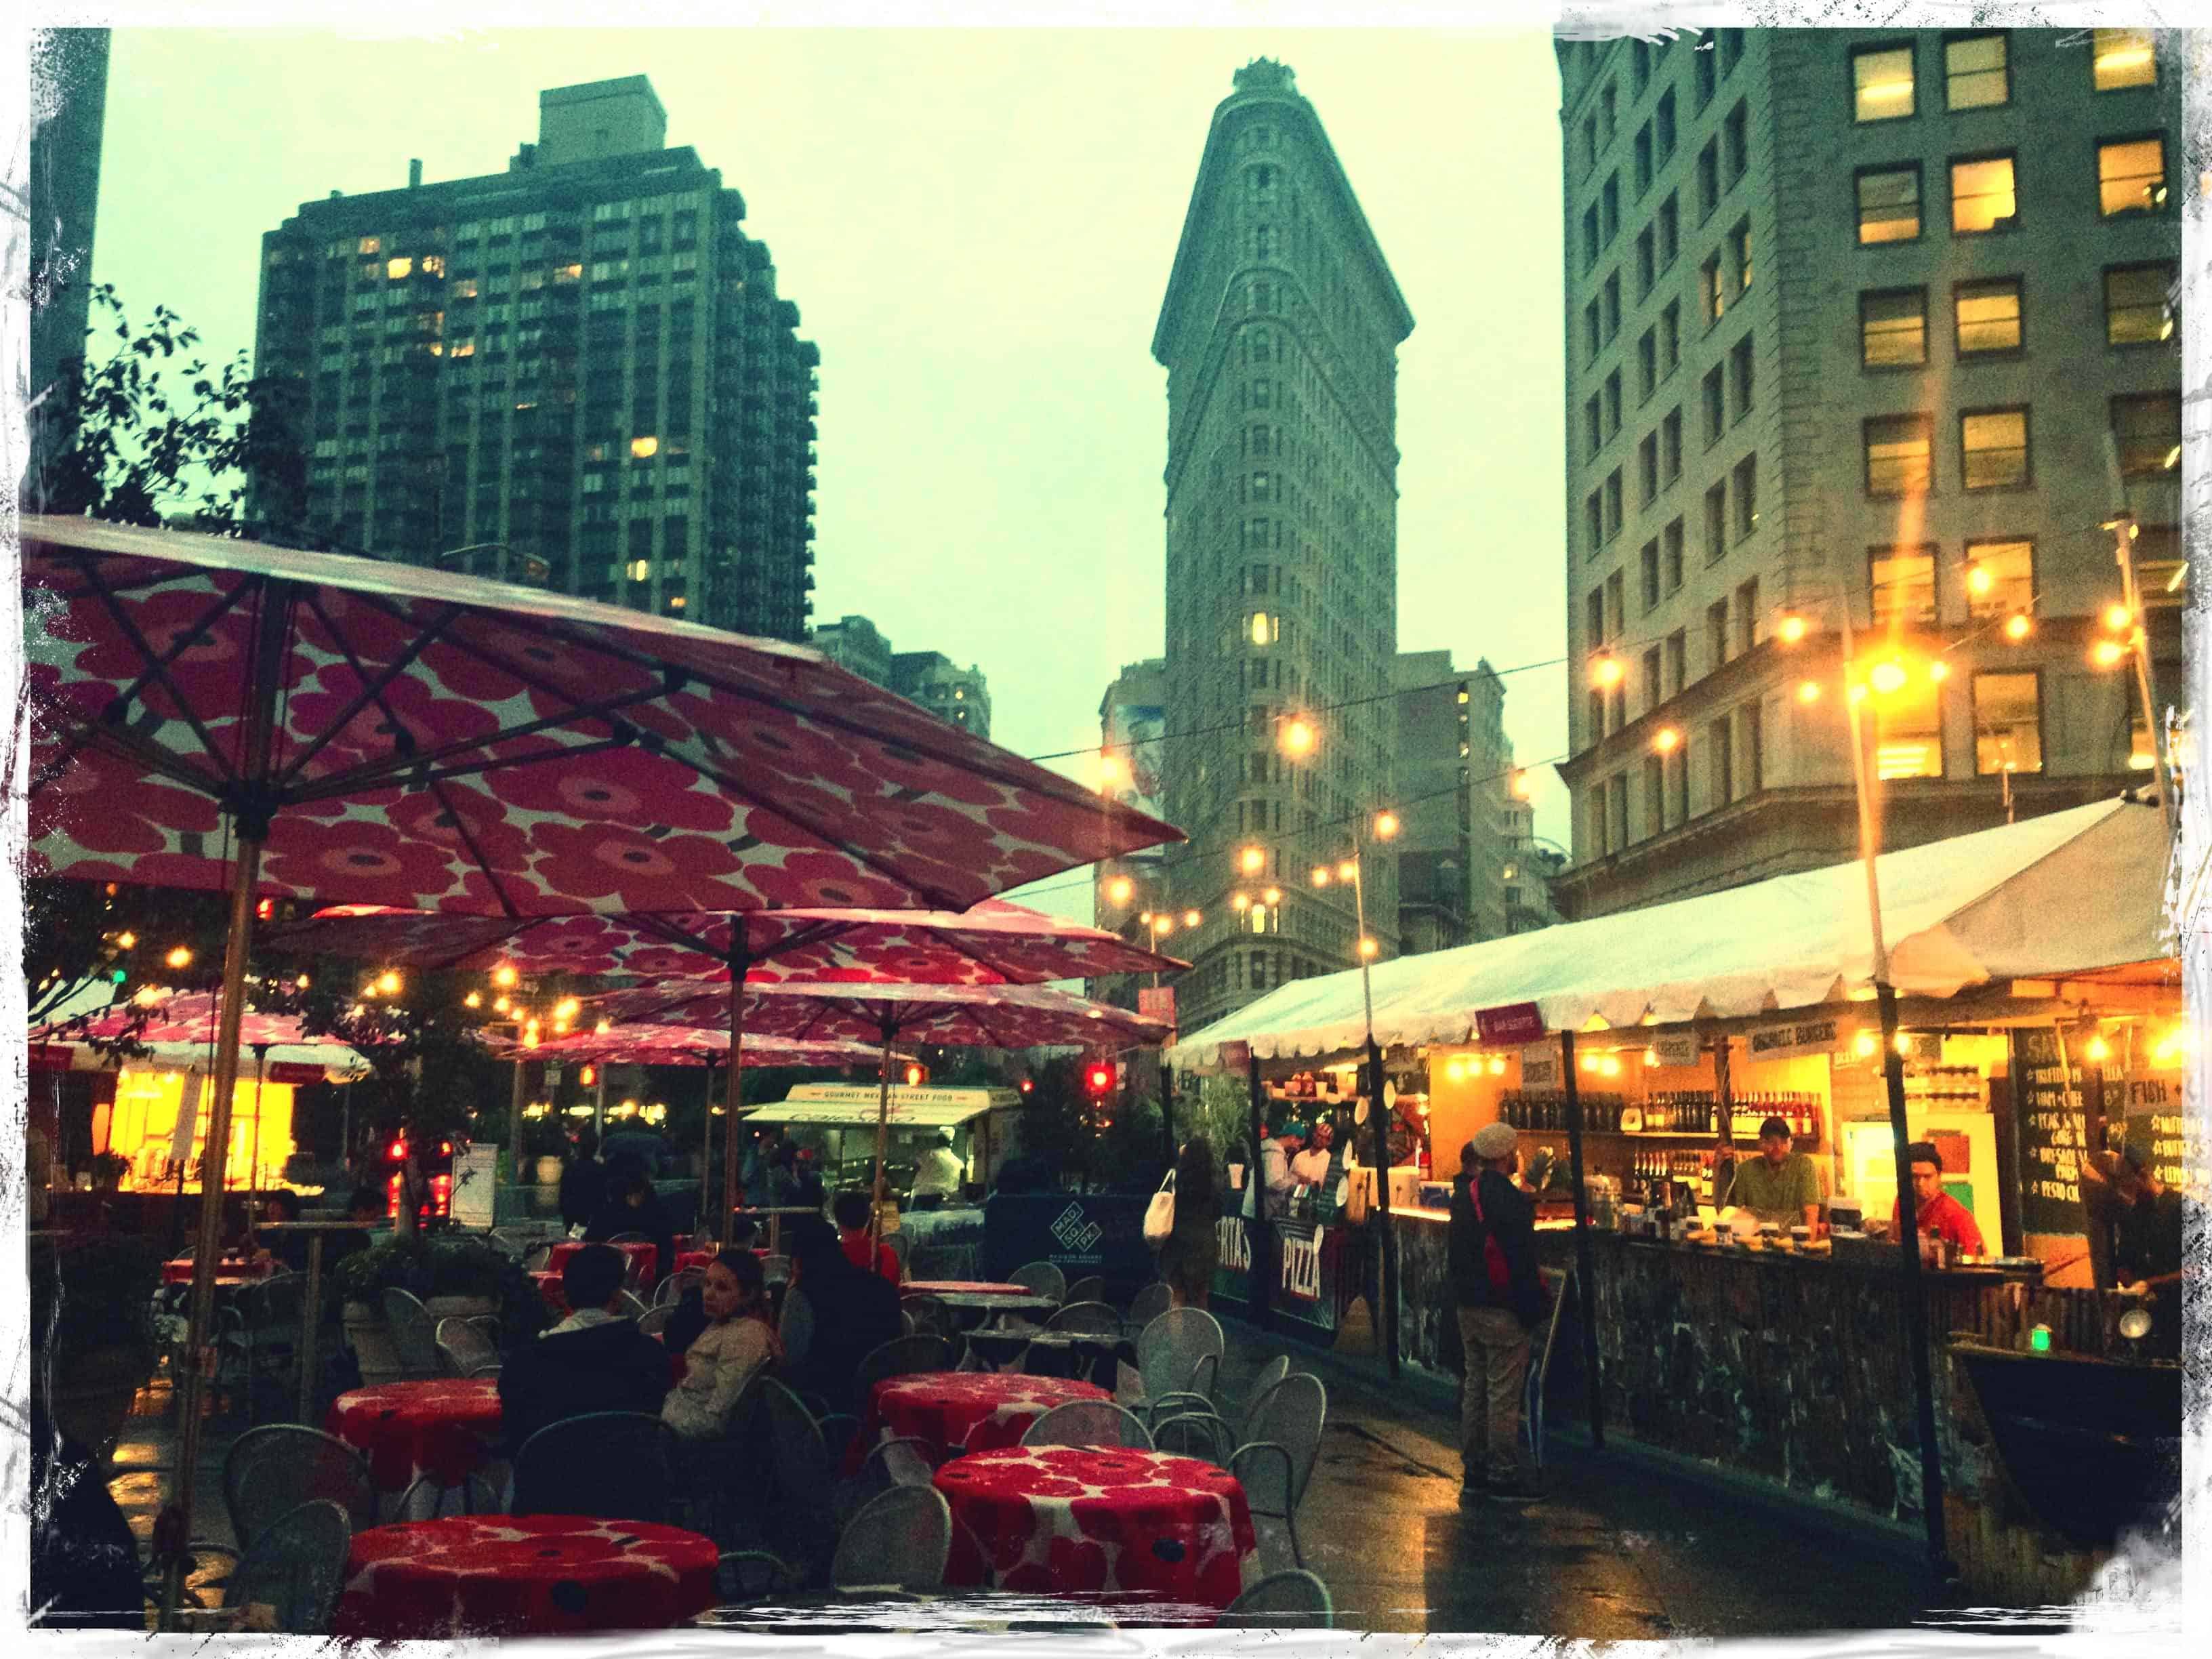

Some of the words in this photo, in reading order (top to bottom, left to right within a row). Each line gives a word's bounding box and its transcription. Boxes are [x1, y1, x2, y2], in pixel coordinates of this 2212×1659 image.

[824, 1091, 859, 1101] GOURMET
[864, 1092, 897, 1101] MEXAN
[1282, 1235, 1321, 1298] PIZZA
